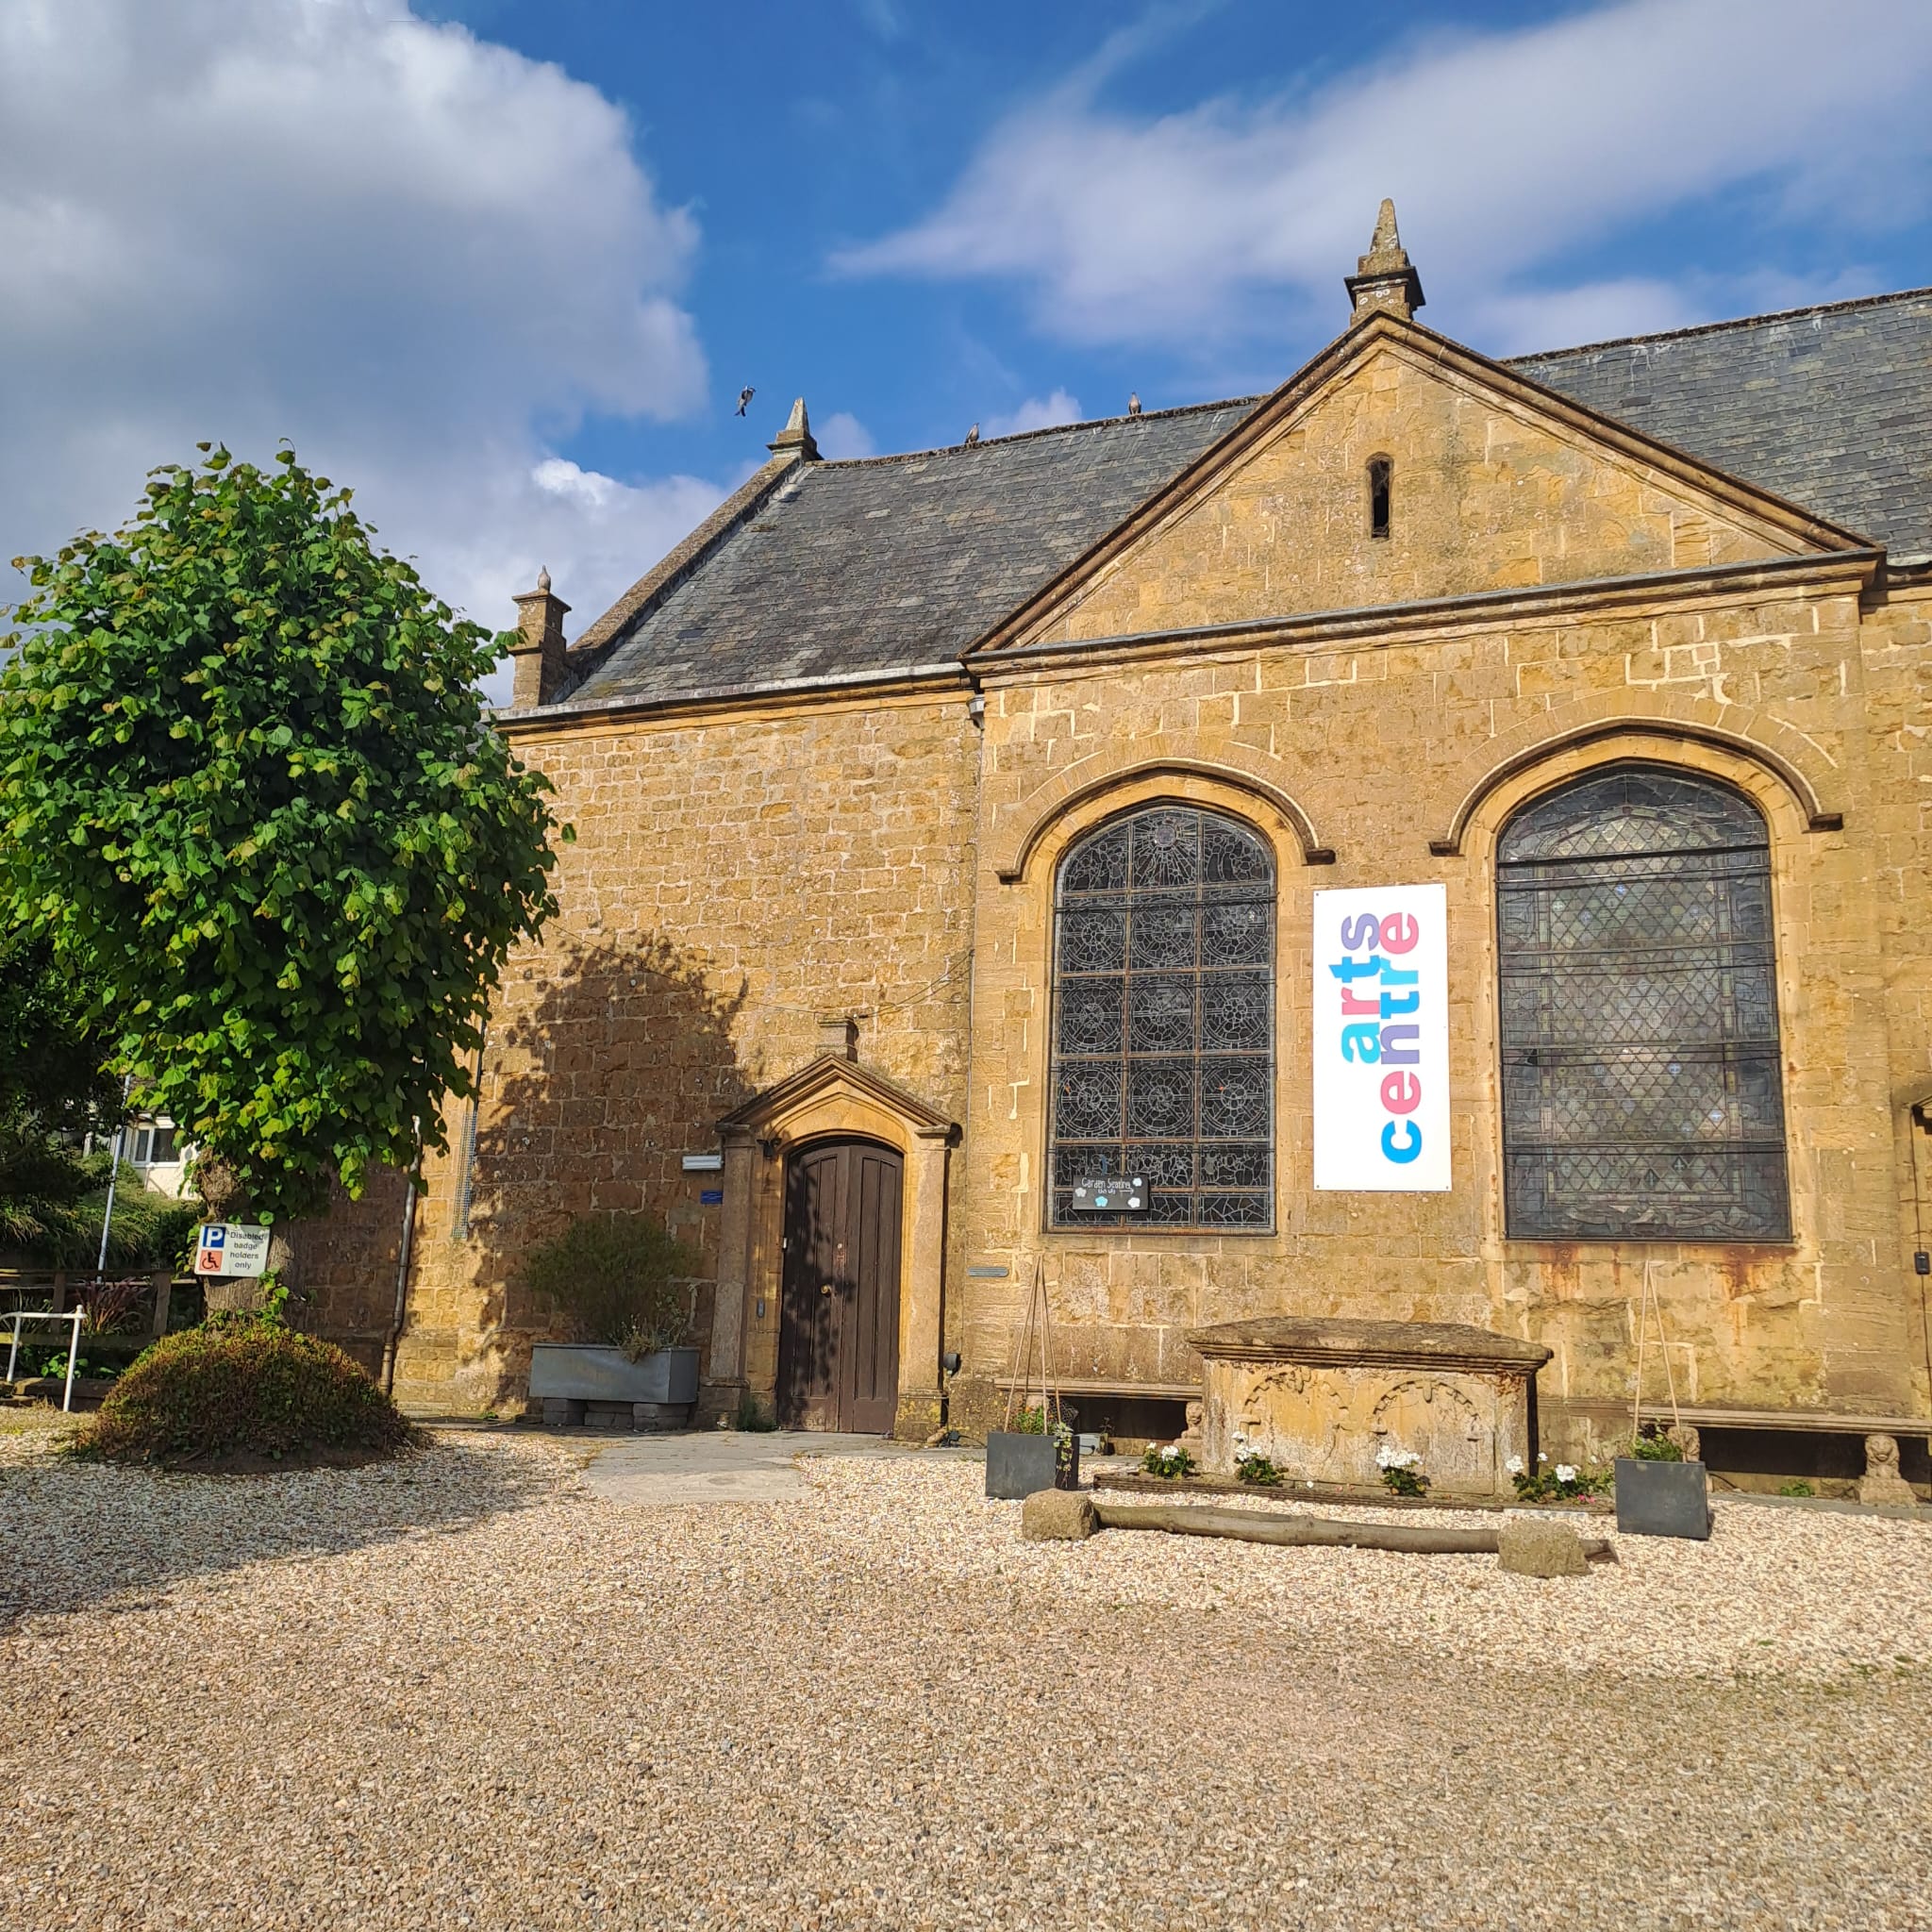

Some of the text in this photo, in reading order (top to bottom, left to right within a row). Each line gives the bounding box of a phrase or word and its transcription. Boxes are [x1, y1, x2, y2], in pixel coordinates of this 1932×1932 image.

[1328, 912, 1381, 1063] arts
[1378, 912, 1422, 1163] centre
[1081, 1177, 1106, 1189] Garden
[206, 1226, 224, 1247] P
[230, 1231, 265, 1241] Disabled
[234, 1241, 258, 1250] badge
[235, 1261, 252, 1270] only
